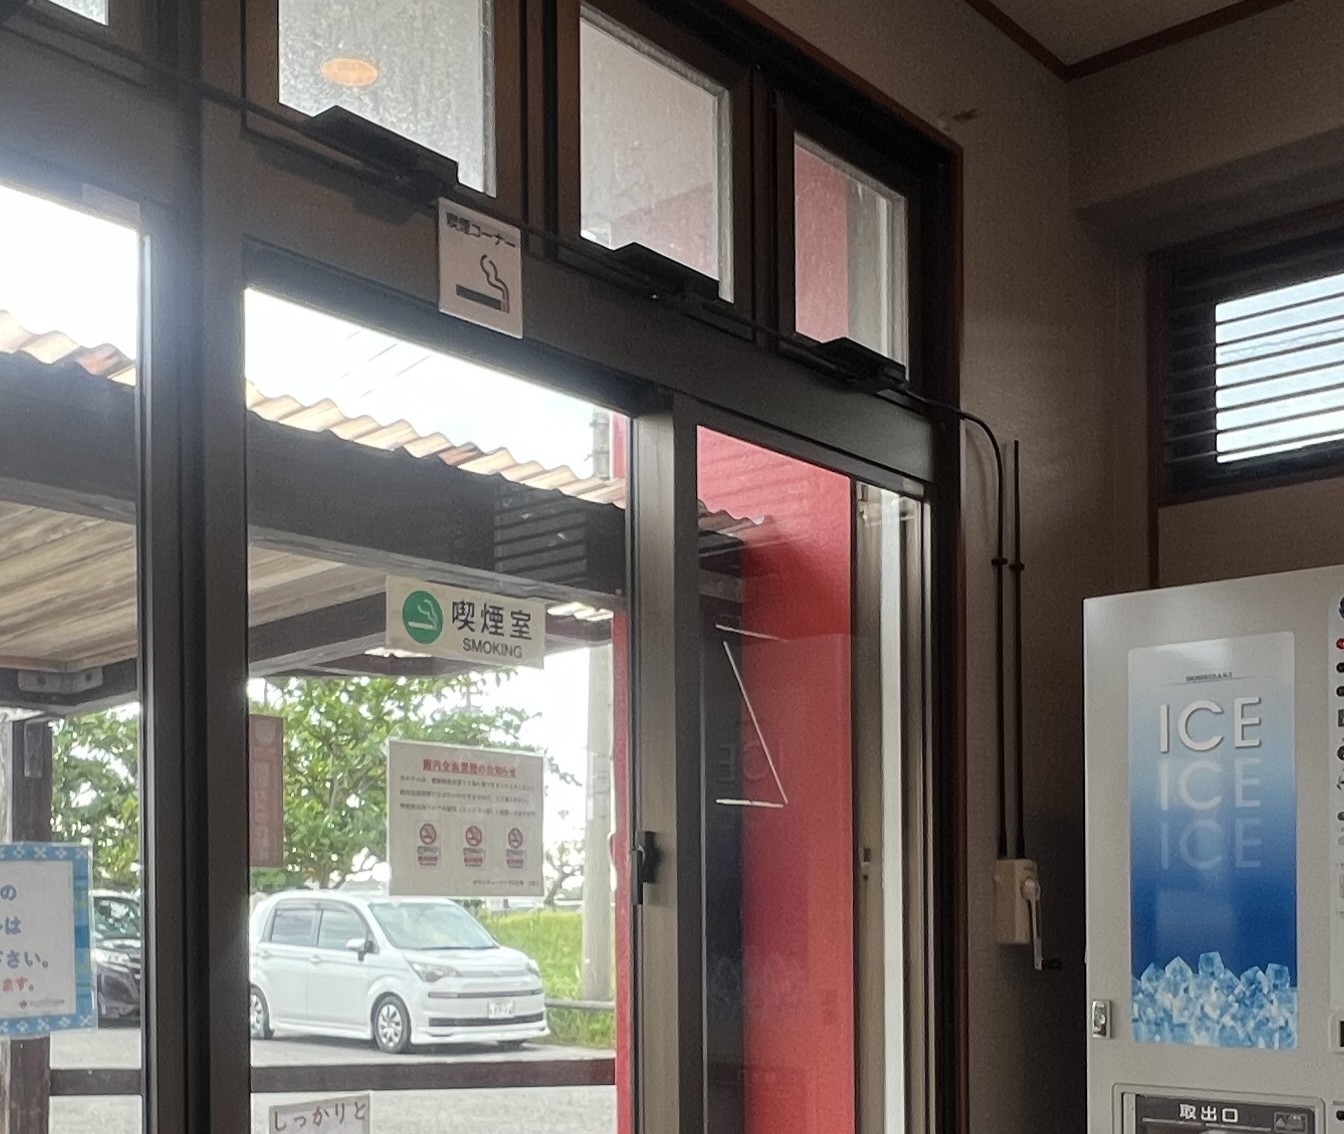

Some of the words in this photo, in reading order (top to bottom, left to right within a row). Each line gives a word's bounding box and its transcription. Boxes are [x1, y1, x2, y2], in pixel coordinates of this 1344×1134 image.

[451, 599, 533, 642] 喫煙室
[462, 637, 523, 660] SMOKING
[1159, 696, 1262, 754] ICE
[1159, 757, 1262, 811] ICE
[1159, 816, 1262, 870] ICE
[273, 1101, 367, 1133] しっかりと
[1179, 1103, 1239, 1123] 取出口
